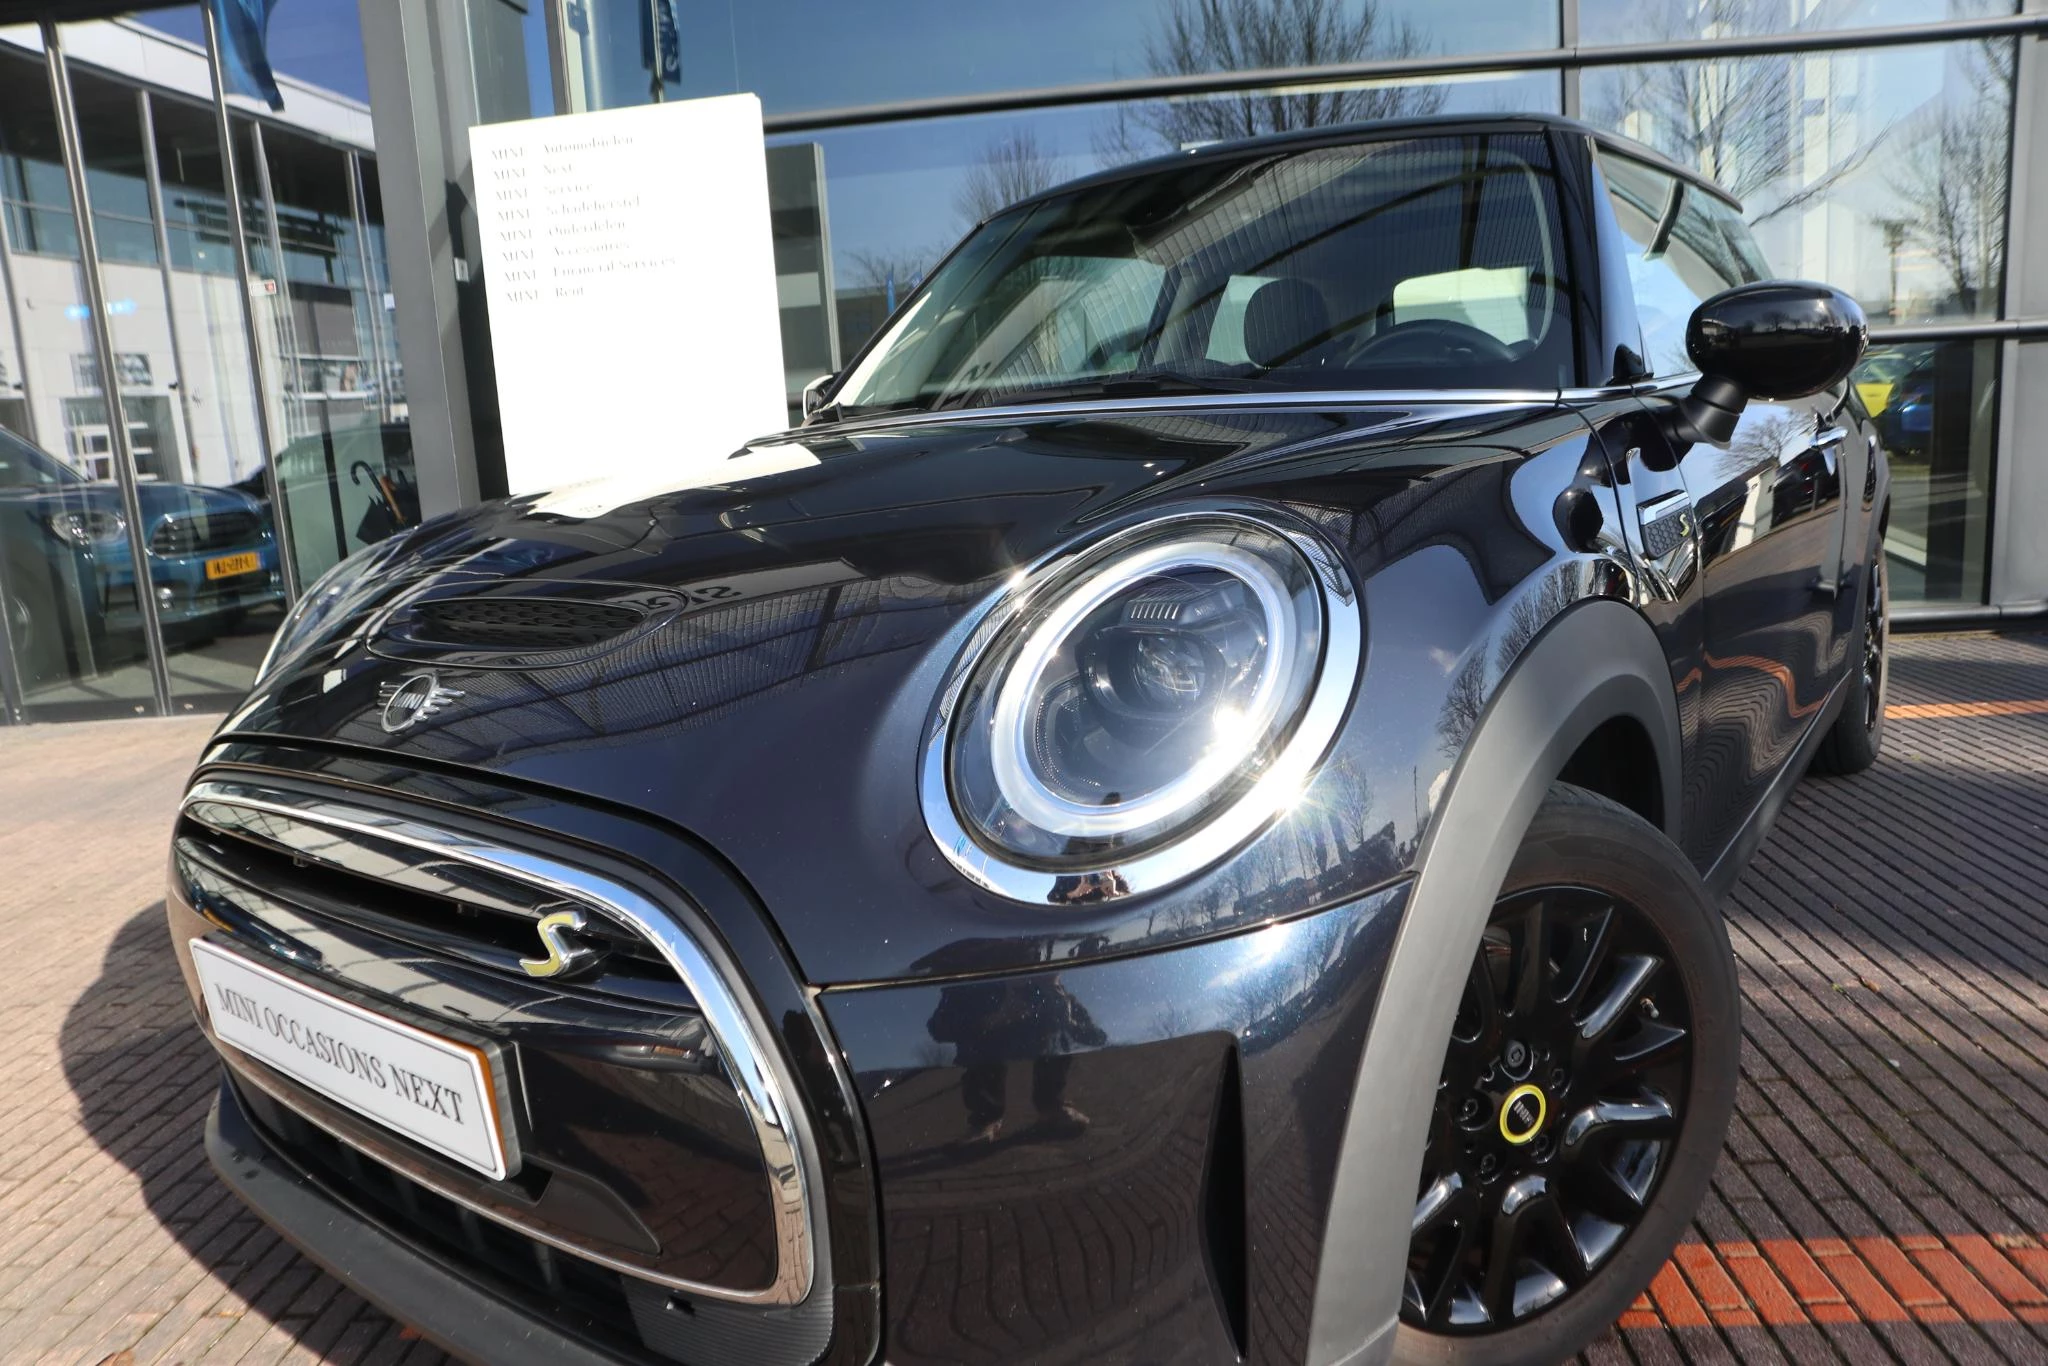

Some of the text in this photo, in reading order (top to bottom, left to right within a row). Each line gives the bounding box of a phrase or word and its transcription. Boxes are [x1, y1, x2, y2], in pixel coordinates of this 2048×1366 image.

[1679, 513, 1690, 537] S
[390, 692, 426, 710] MINI
[518, 910, 584, 978] S
[214, 983, 465, 1125] MINI OCCASIONS NEXT
